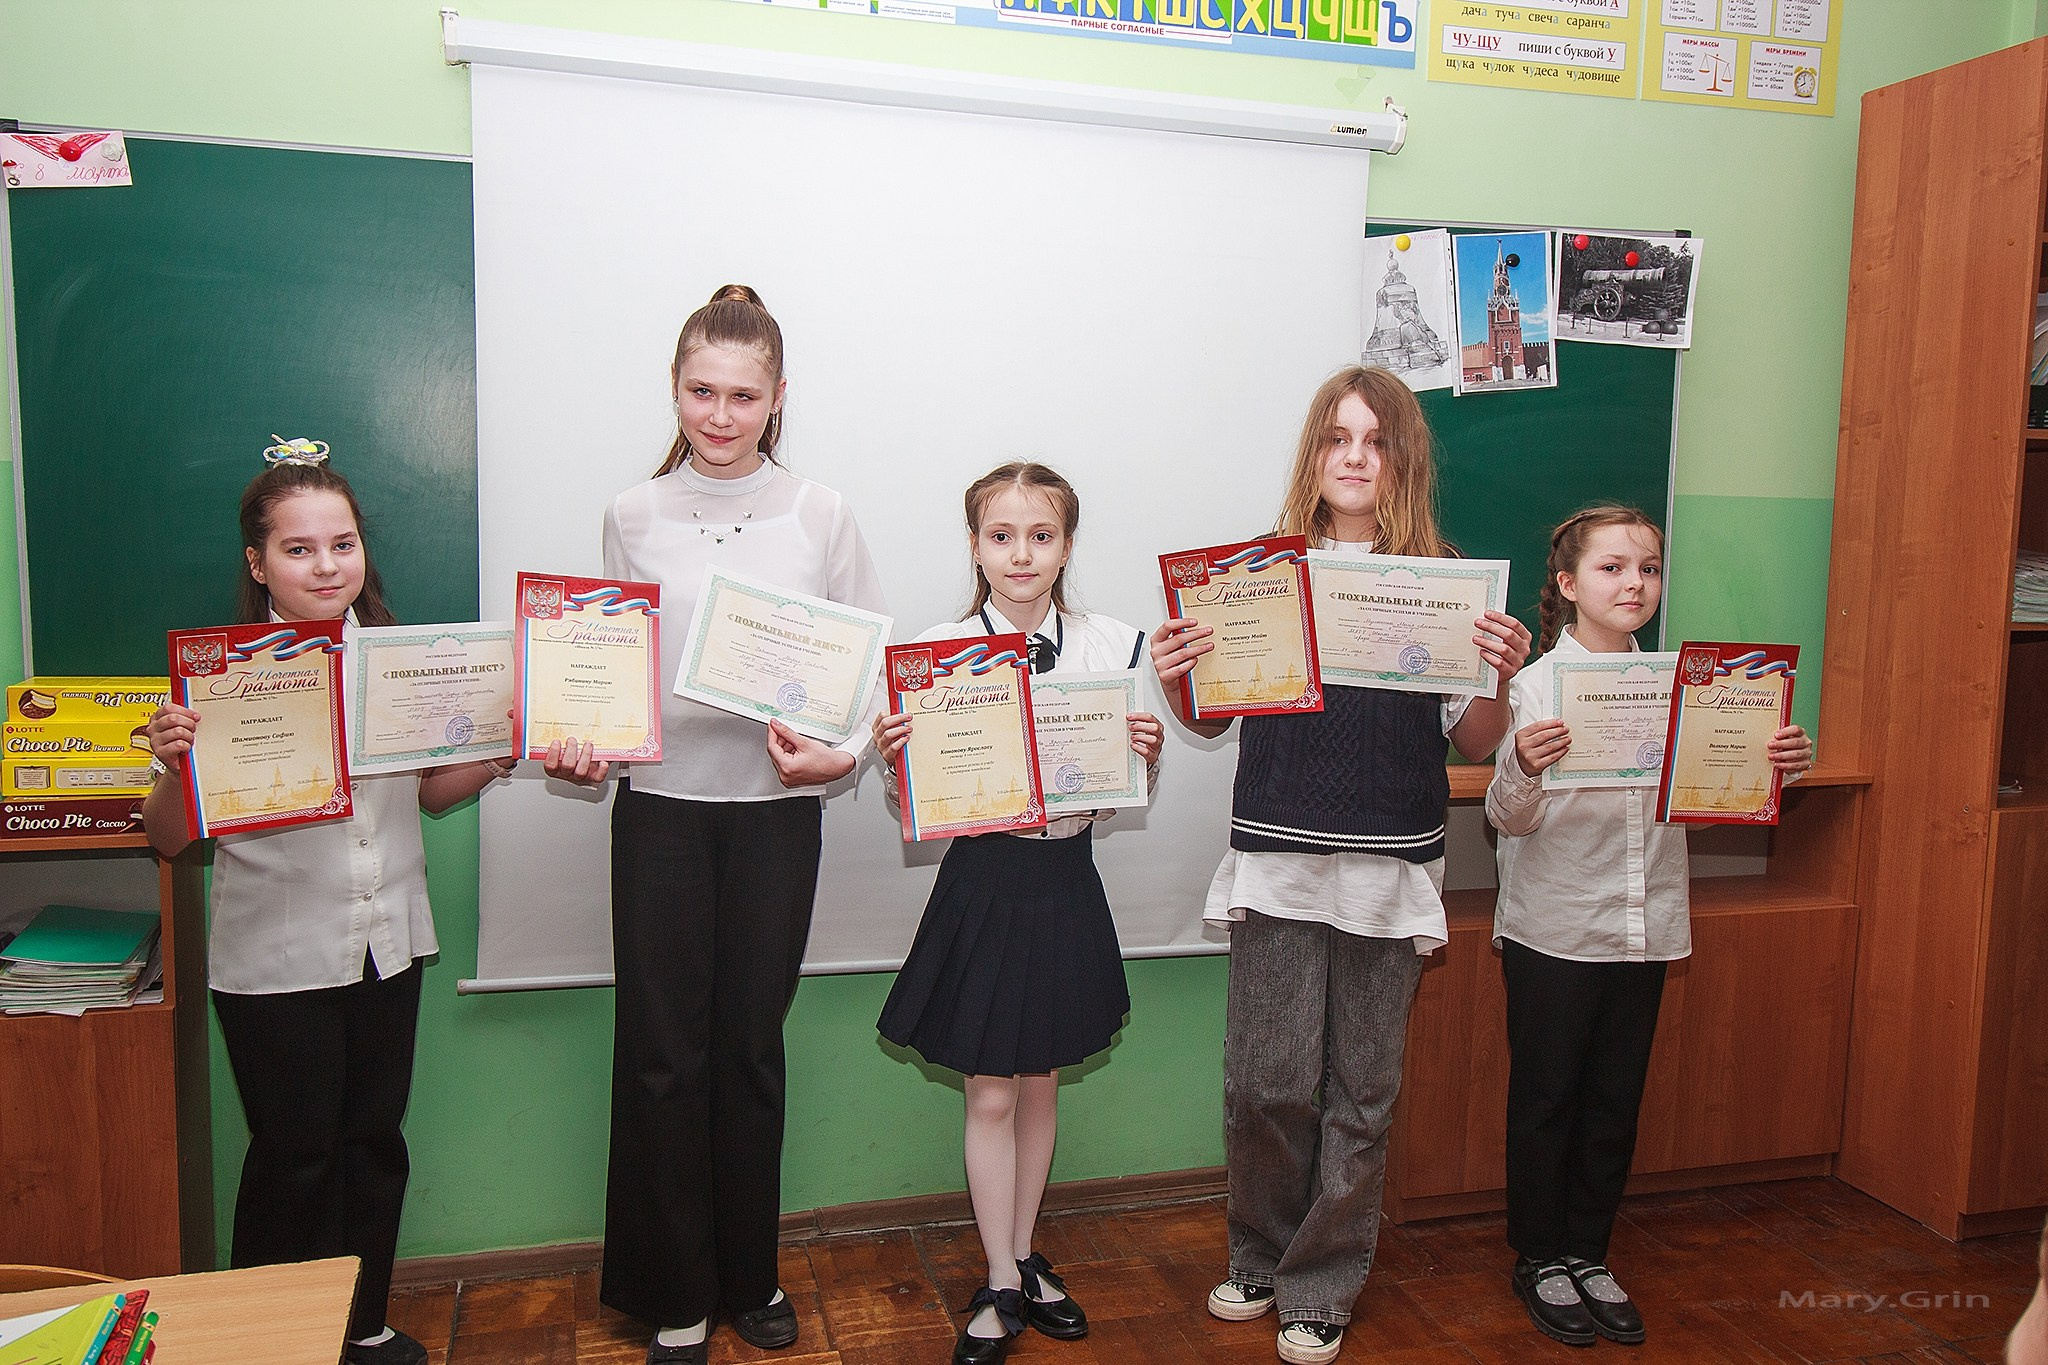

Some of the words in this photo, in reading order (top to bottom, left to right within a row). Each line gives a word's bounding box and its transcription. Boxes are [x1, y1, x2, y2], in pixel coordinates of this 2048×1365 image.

[1236, 0, 1266, 33] Х
[1273, 0, 1304, 39] Ц
[1312, 0, 1339, 40] Ч
[1344, 0, 1377, 45] Щ
[1382, 1, 1412, 43] Ъ
[1462, 5, 1487, 16] дача
[1495, 9, 1520, 22] туча
[1528, 12, 1559, 24] свеча
[1566, 15, 1611, 29] саранча
[1071, 19, 1108, 30] ПАРНЫЕ
[1110, 23, 1165, 35] СОГЛАСНЫЕ
[1452, 32, 1501, 50] ЧУ-ЩУ
[1519, 41, 1551, 55] пиши
[1554, 46, 1561, 55] с
[1563, 43, 1604, 60] буквой
[1607, 48, 1617, 61] У
[1446, 58, 1475, 70] щука
[1482, 61, 1515, 75] чулок
[1522, 65, 1559, 78] чудеса
[1566, 70, 1621, 83] чудовище
[35, 163, 45, 181] 8
[1231, 577, 1288, 590] Почетная
[1196, 581, 1289, 605] Грамота
[1338, 592, 1422, 608] ПОХВАЛЬНЫЙ
[1425, 600, 1462, 611] ЛИСТ
[584, 622, 639, 634] Почетная
[1224, 619, 1260, 627] НАГРАЖДАЕТ
[546, 619, 639, 645] Грамота
[735, 614, 812, 645] ПОХВАЛЬНЫЙ
[812, 637, 846, 655] ЛИСТ
[247, 669, 319, 681] Почетная
[391, 665, 467, 679] ПОХВАЛЬНЫЙ
[469, 663, 499, 673] ЛИСТ
[210, 671, 319, 699] Грамота
[956, 682, 1010, 695] Почетная
[1729, 684, 1776, 697] Почетная
[94, 692, 125, 707] Pie
[920, 686, 1010, 713] Грамота
[1584, 692, 1657, 702] ПОХВАЛЬНЫЙ
[1697, 684, 1775, 710] Грамота
[240, 716, 283, 725] НАГРАЖДАЕТ
[1073, 712, 1106, 722] ЛИСТ
[947, 729, 983, 738] НАГРАЖДАЕТ
[7, 737, 60, 753] Choco
[62, 737, 91, 752] Pie
[6, 816, 60, 831] Choco
[62, 813, 92, 828] Pie
[96, 819, 127, 828] Cacao
